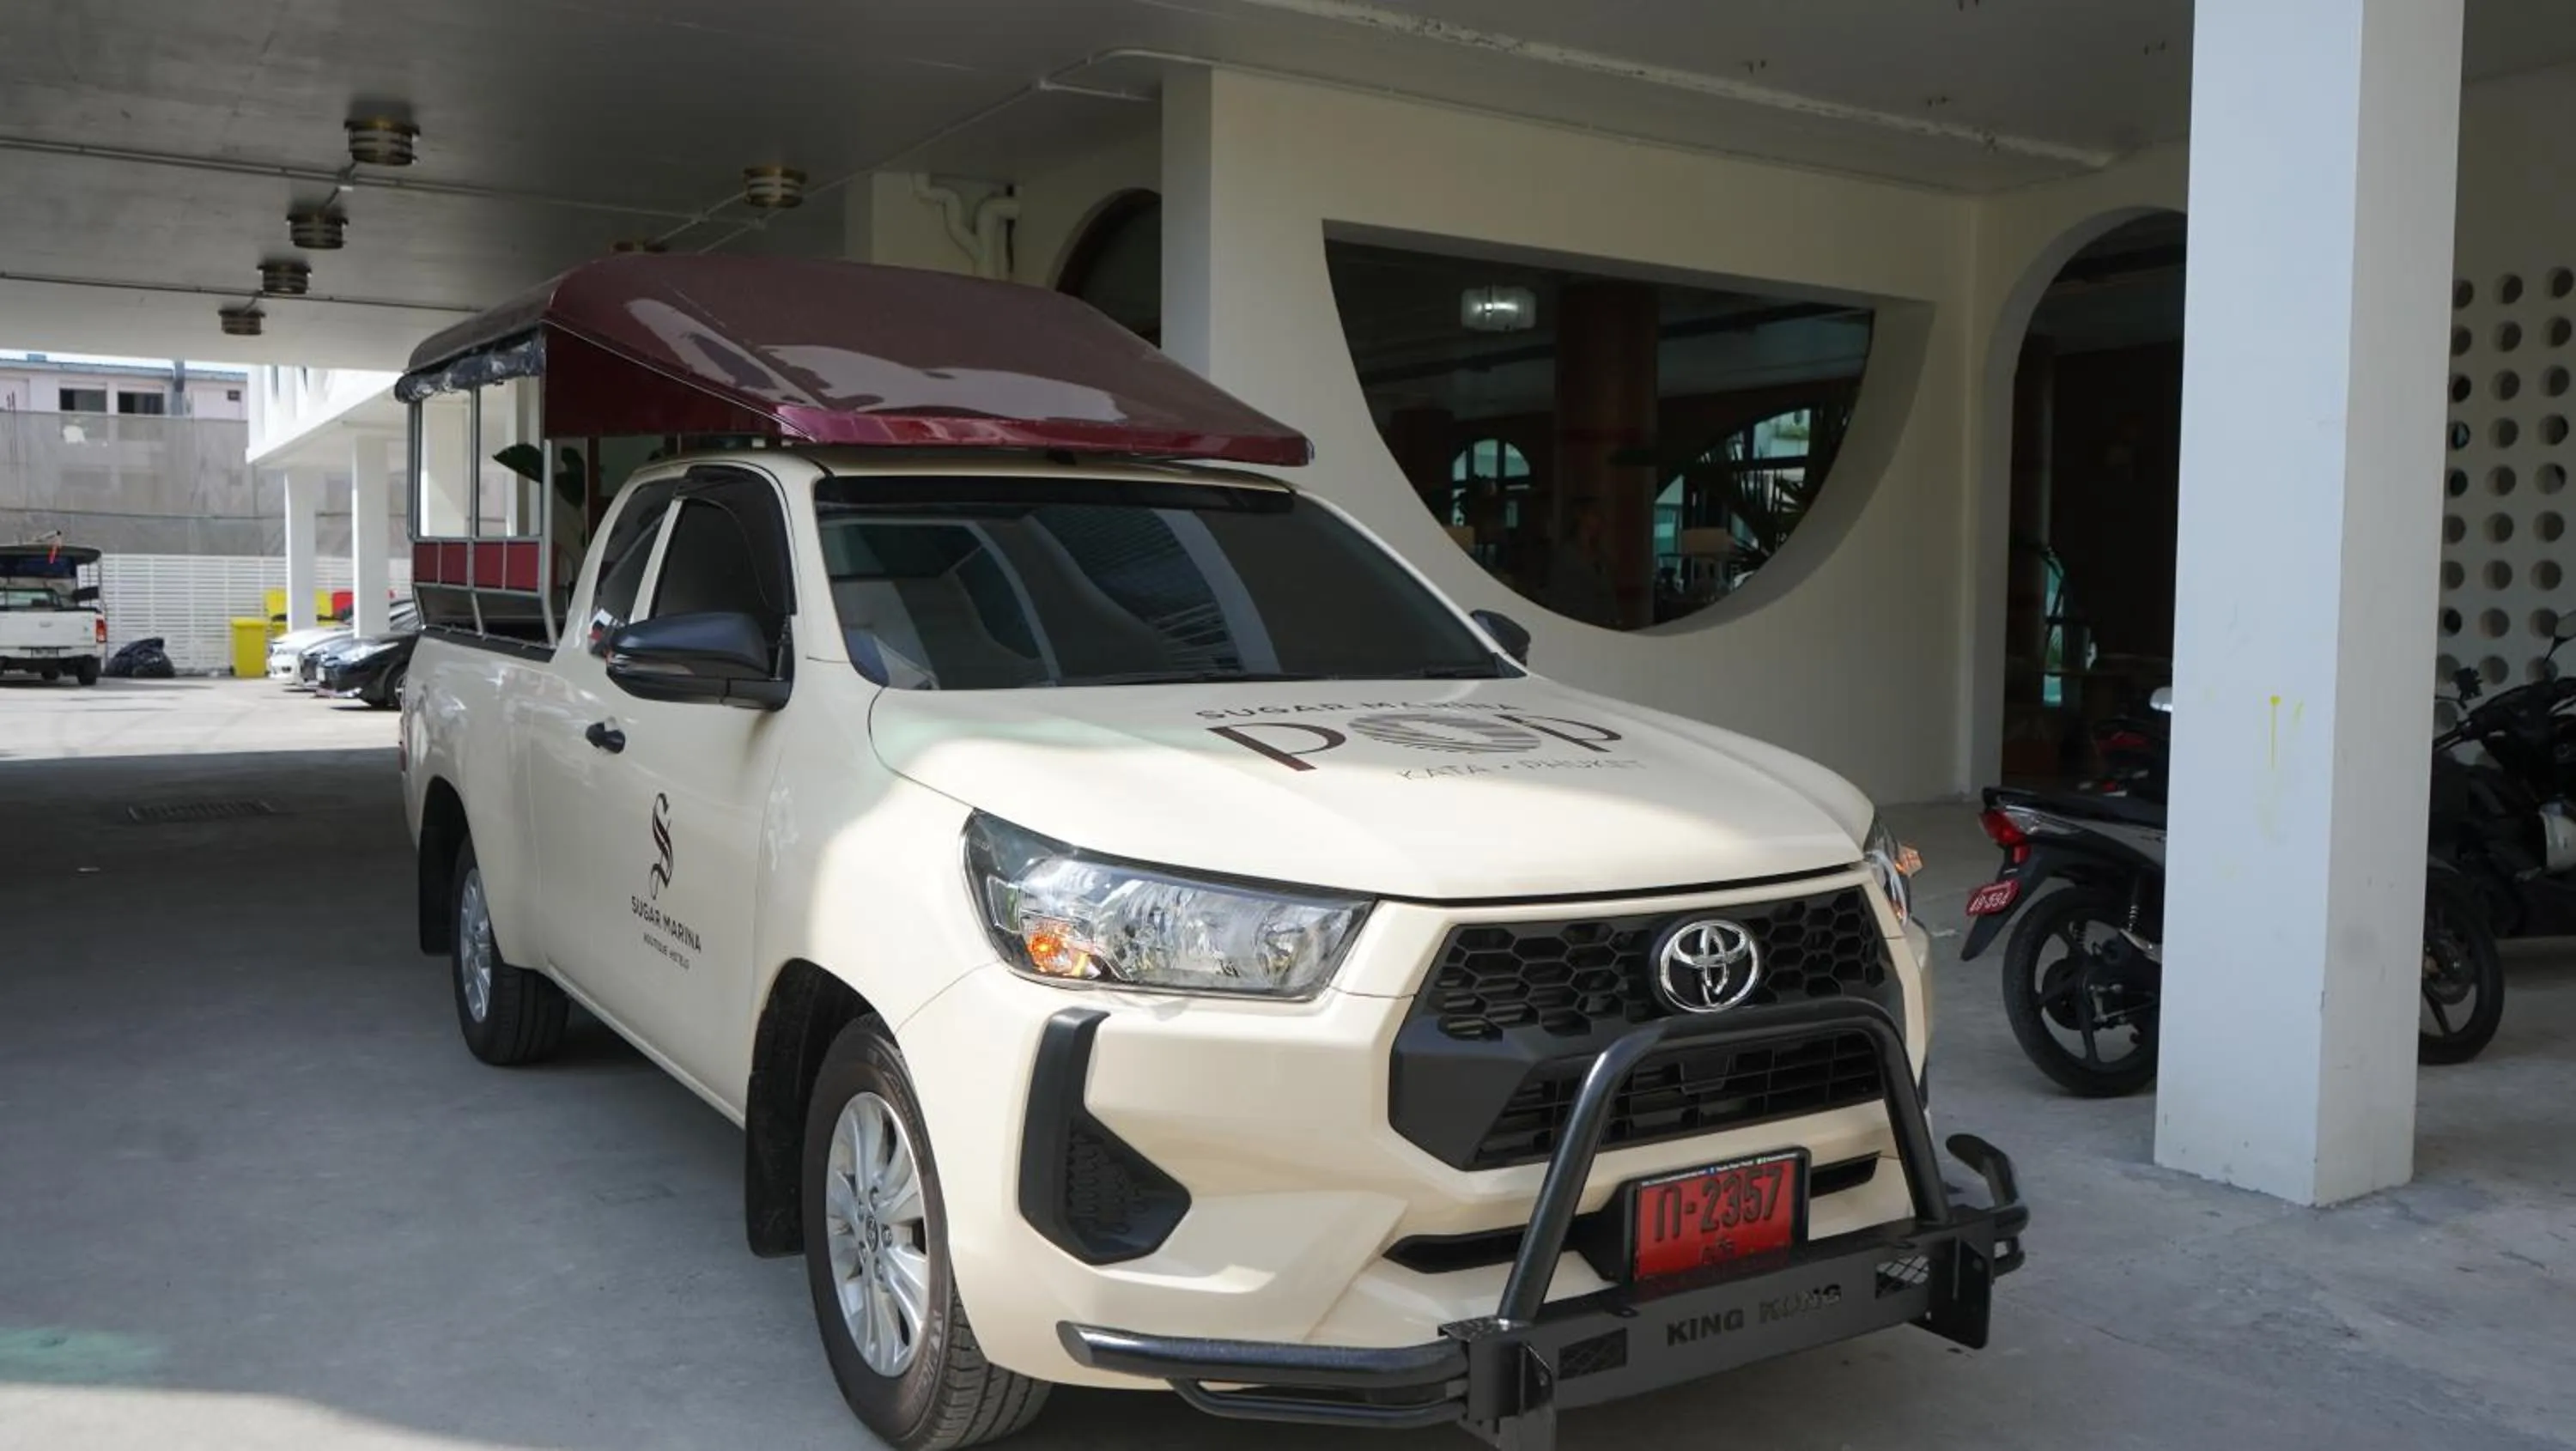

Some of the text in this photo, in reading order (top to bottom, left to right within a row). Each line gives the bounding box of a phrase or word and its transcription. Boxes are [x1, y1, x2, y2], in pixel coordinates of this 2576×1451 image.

[631, 895, 702, 954] SUGAR MARINA
[1667, 1308, 1745, 1347] KING
